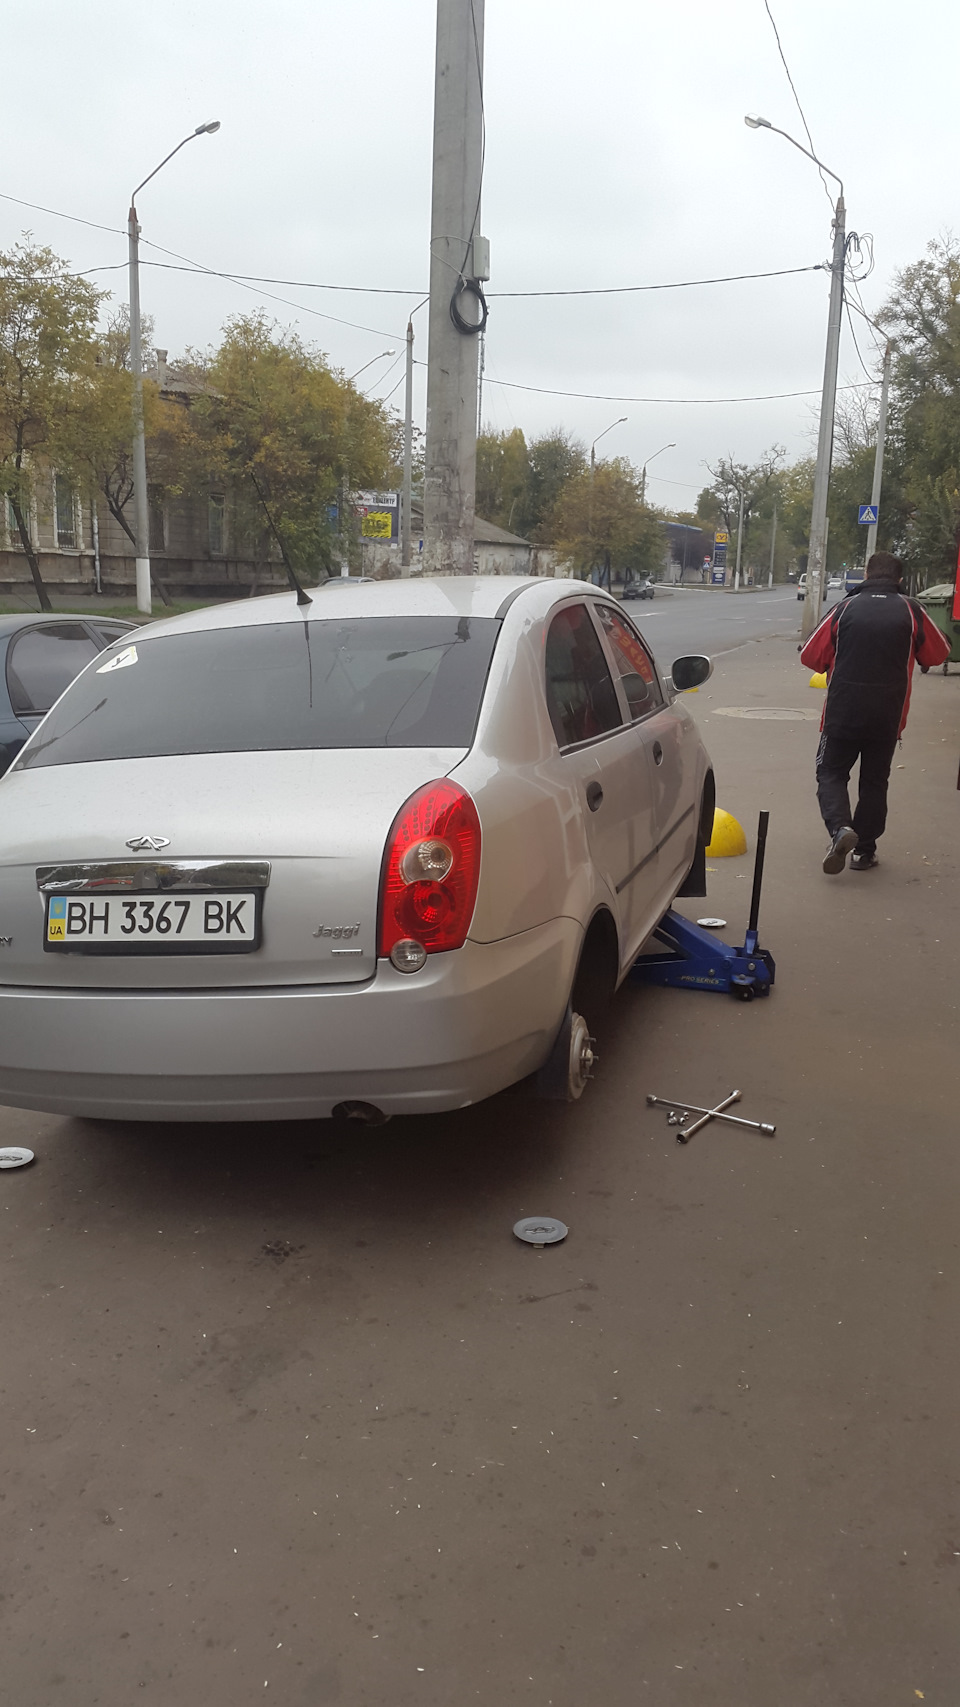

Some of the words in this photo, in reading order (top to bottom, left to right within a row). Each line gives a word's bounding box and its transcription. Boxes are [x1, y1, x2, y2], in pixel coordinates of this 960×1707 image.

[66, 902, 110, 934] BH
[120, 901, 190, 934] 3367
[203, 900, 247, 934] BK
[50, 926, 63, 935] UA
[312, 921, 361, 939] Jaggi
[696, 977, 720, 985] SERIES
